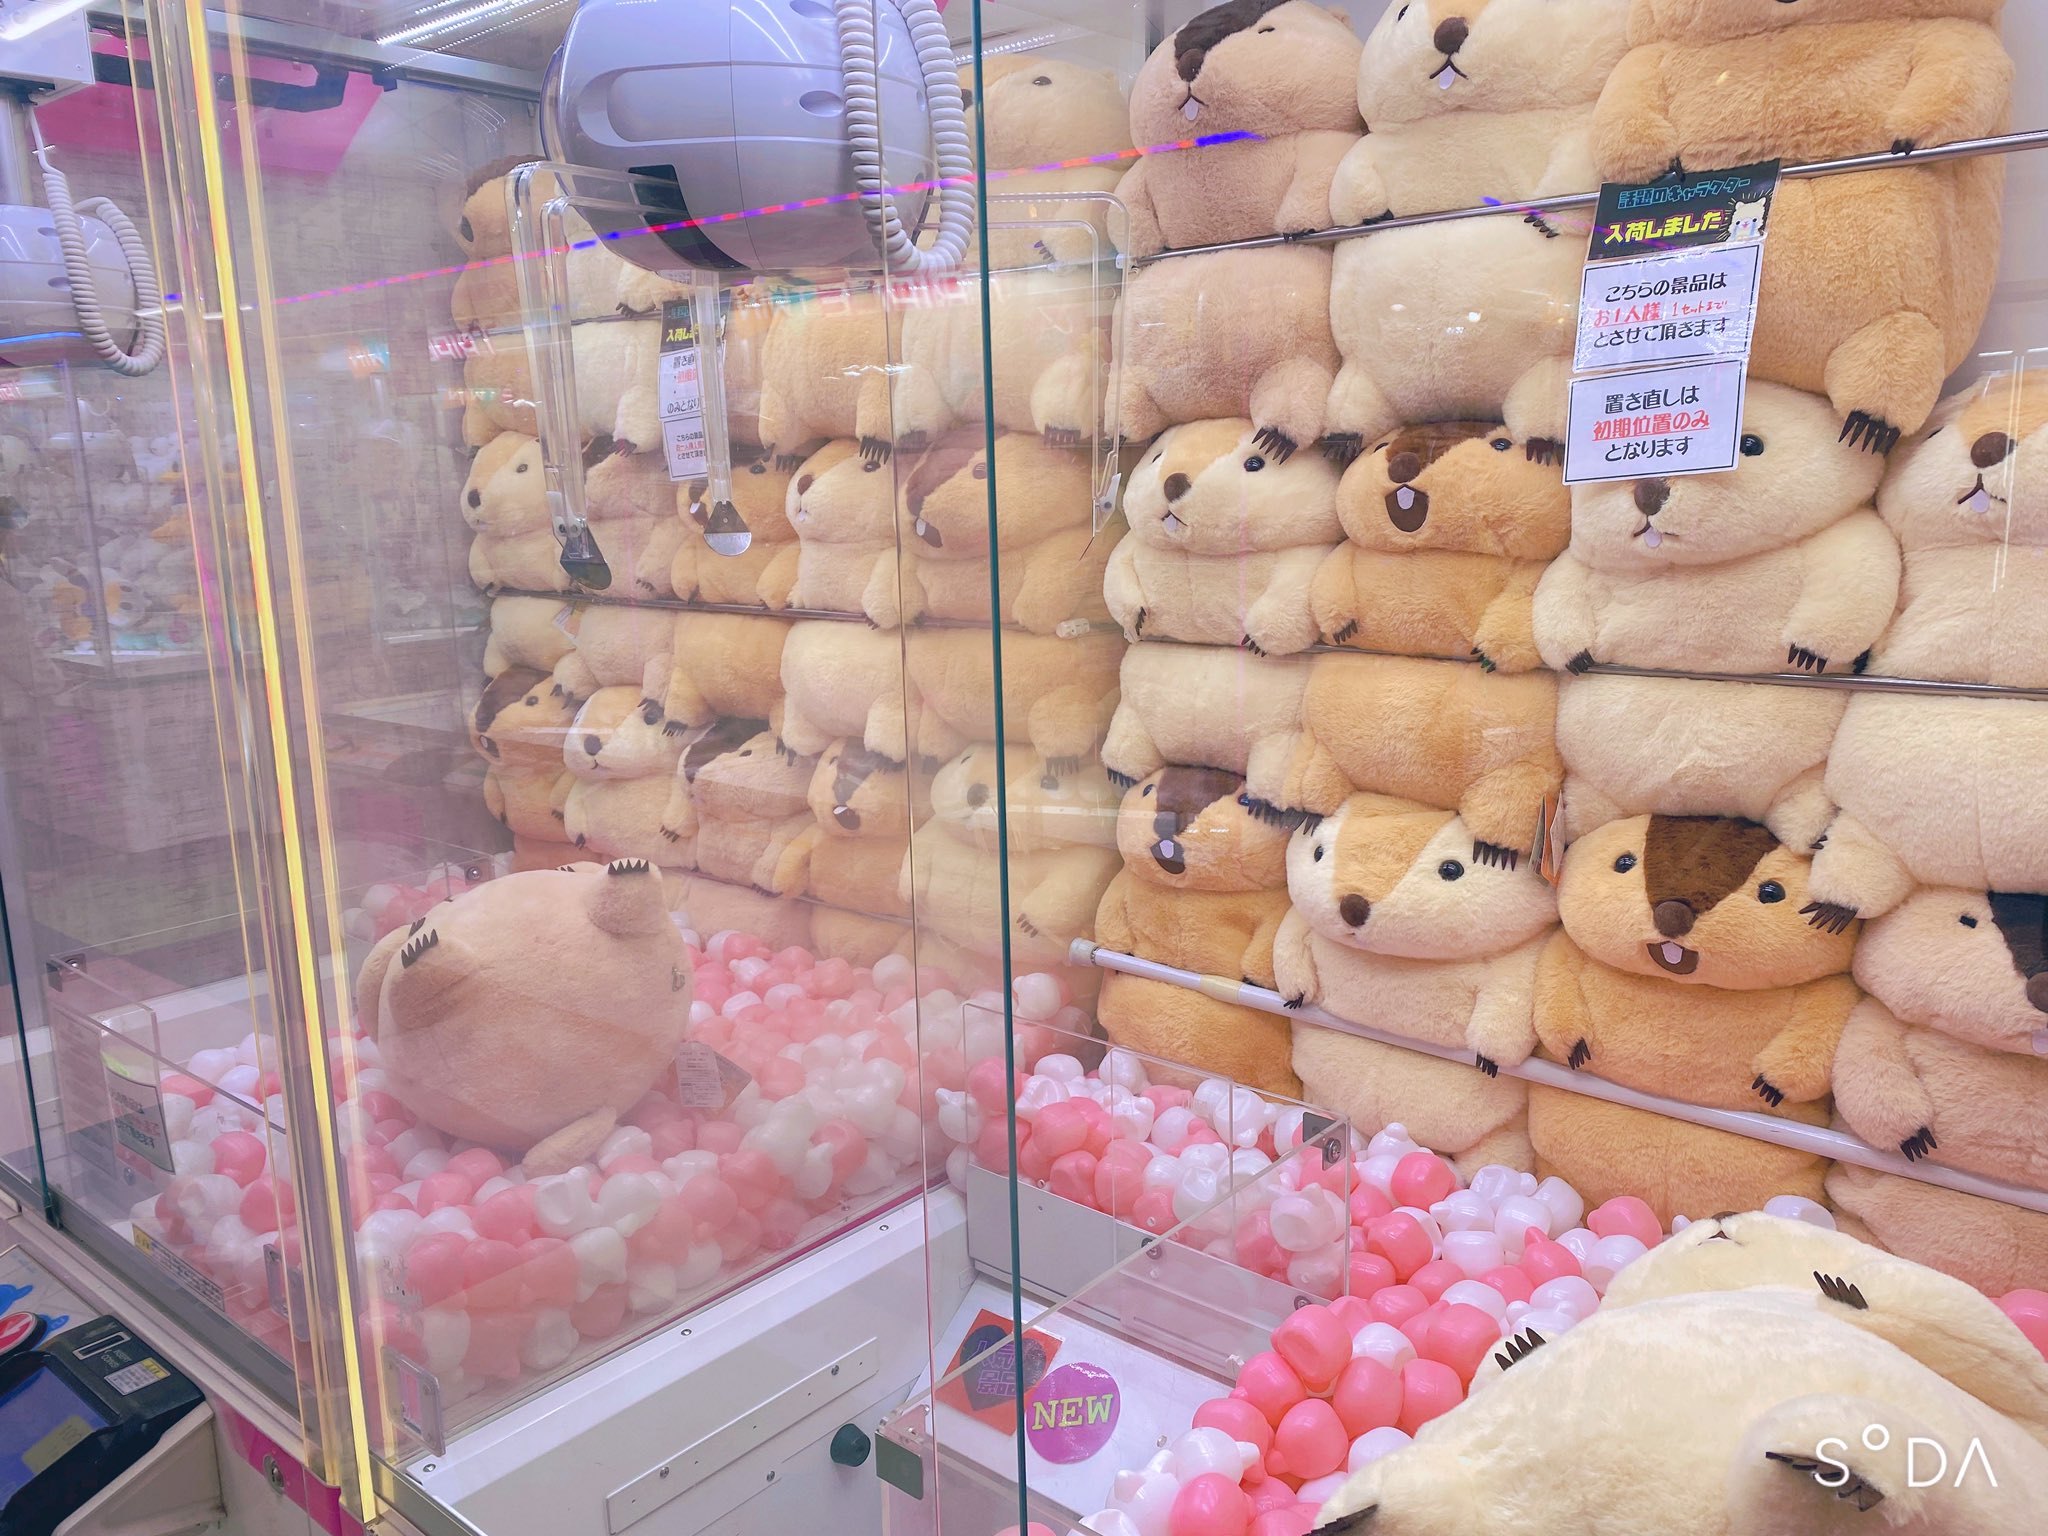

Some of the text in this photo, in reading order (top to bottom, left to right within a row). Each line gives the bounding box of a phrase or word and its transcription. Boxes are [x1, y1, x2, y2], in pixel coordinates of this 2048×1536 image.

[1617, 176, 1751, 210] 話題のキャラクター
[1603, 210, 1724, 246] 入荷しました
[1605, 271, 1728, 303] こちらの景品は
[1593, 316, 1731, 349] とさせて頂きます
[1604, 385, 1700, 415] 置き直しは
[1592, 409, 1710, 441] 初期位置のみ
[1604, 436, 1694, 463] となります
[1031, 1393, 1114, 1431] NEW
